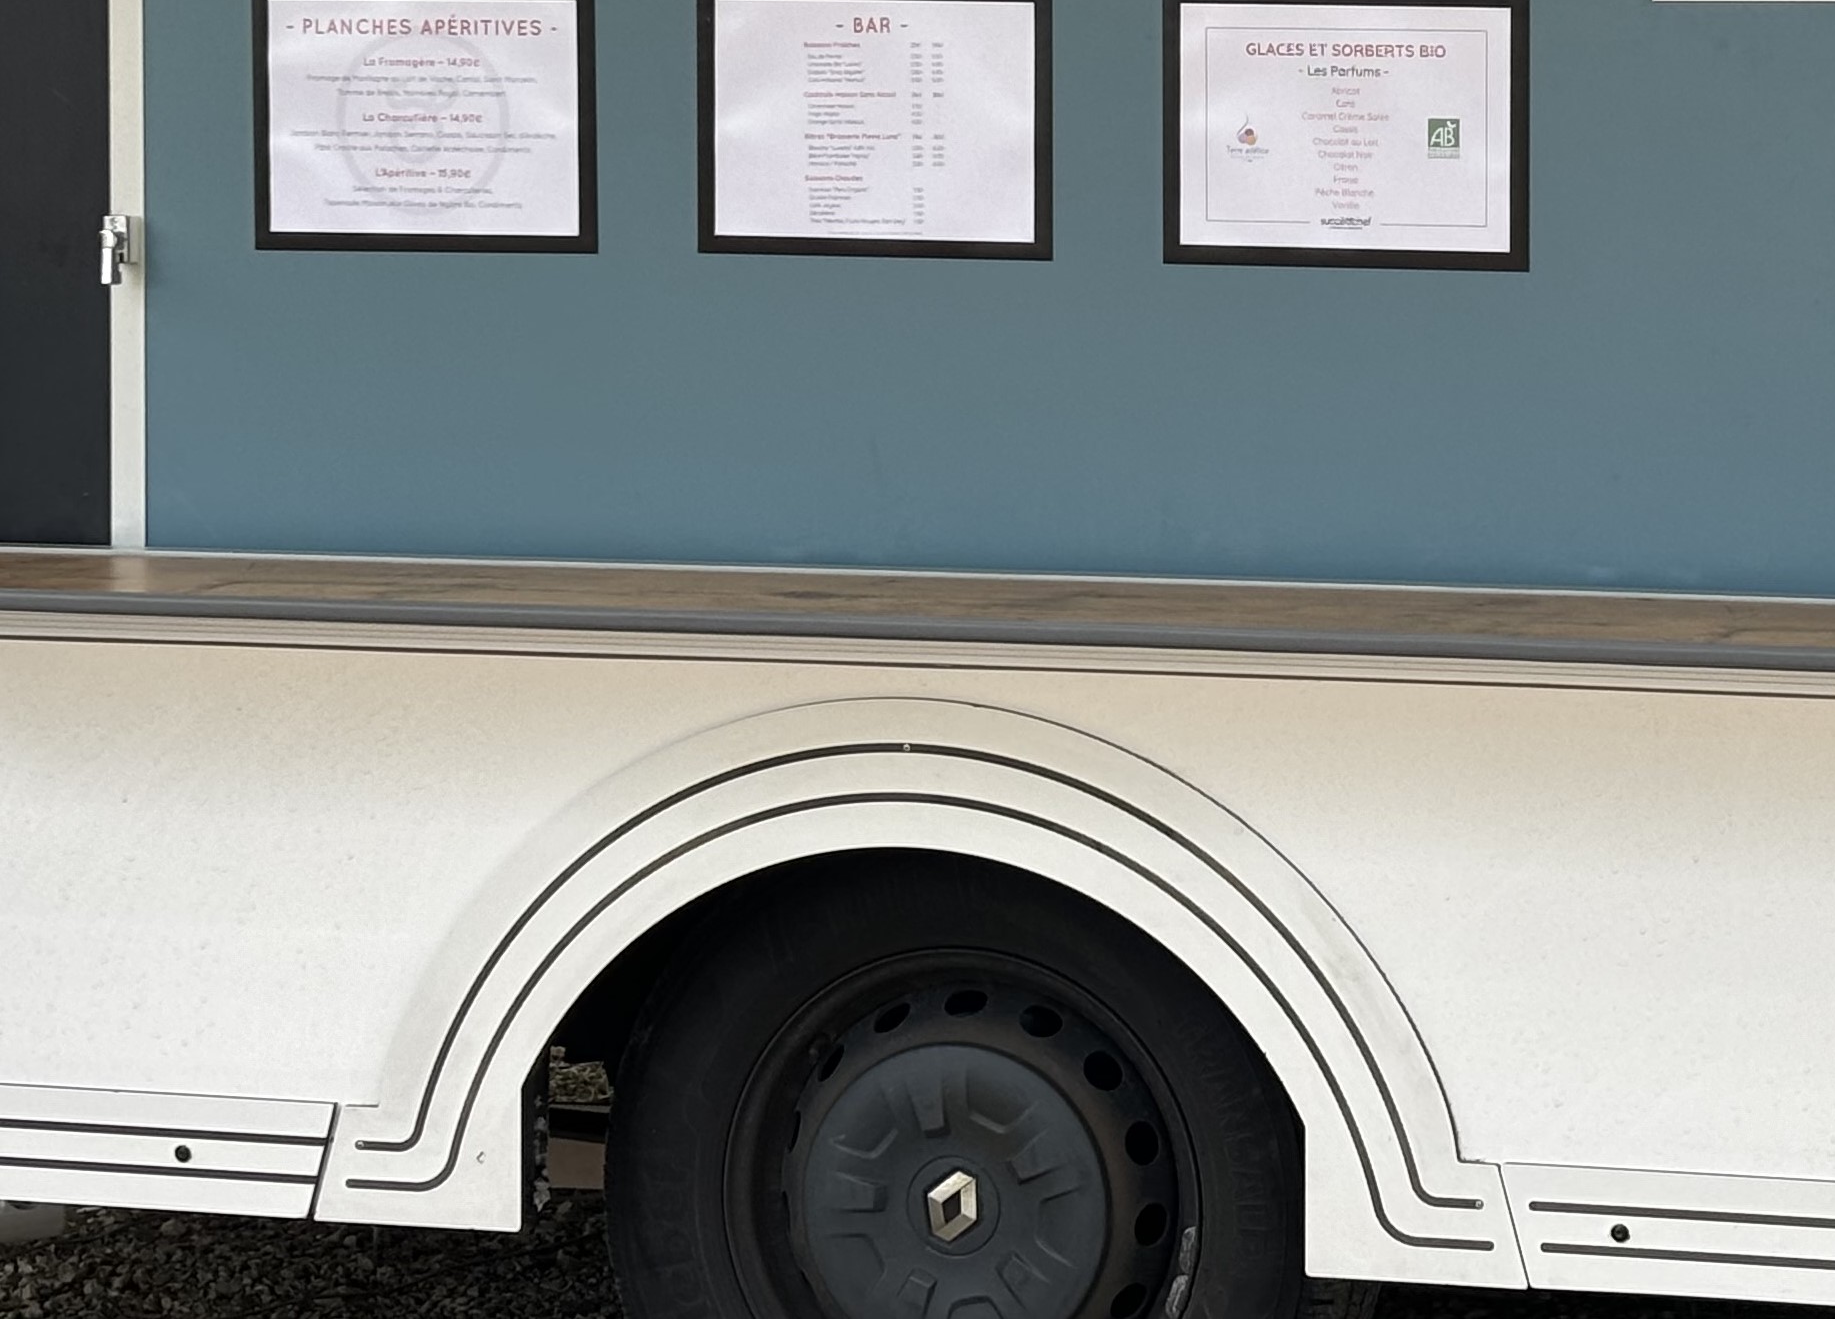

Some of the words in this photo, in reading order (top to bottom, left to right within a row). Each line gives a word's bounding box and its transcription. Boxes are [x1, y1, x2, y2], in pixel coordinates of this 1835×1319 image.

[302, 17, 412, 36] PLANCHES
[420, 13, 543, 37] APÉRITIVES
[853, 17, 891, 33] BAR
[1245, 42, 1305, 57] GLACES
[1309, 43, 1328, 57] ET
[1332, 43, 1415, 58] SORBERTS
[1419, 44, 1447, 58] BIO
[363, 57, 376, 67] La
[378, 57, 435, 69] Fromagère
[1307, 65, 1327, 77] Les
[1330, 65, 1381, 78] Parfums
[363, 113, 375, 122] La
[1301, 111, 1337, 121] Caramel
[1430, 127, 1455, 146] AB
